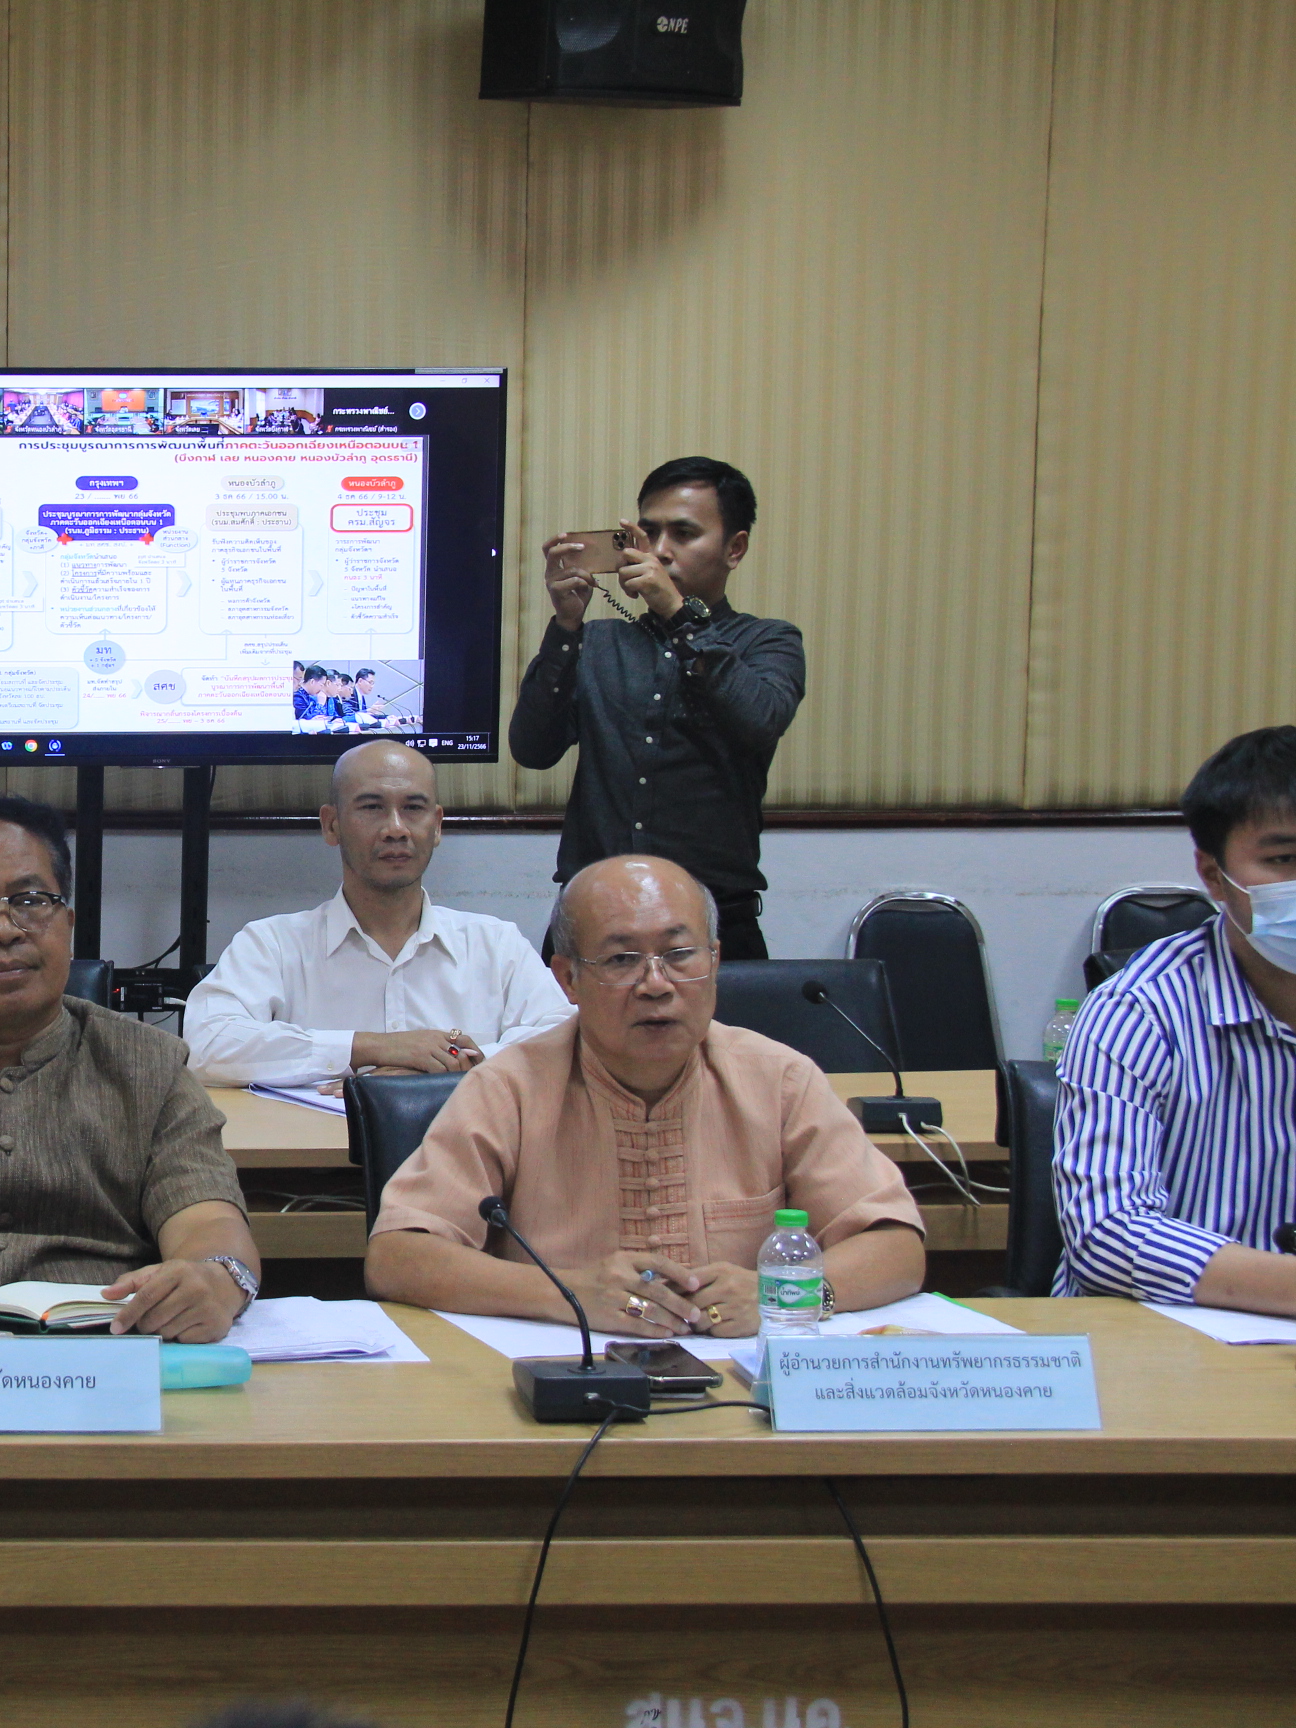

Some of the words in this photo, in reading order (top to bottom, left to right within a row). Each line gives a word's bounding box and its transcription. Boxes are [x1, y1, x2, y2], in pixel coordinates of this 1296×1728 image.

[668, 17, 689, 33] NPE
[413, 441, 418, 449] 1
[174, 453, 216, 465] (บึงกาฬ
[220, 453, 240, 465] เลย
[244, 453, 296, 465] หนองคาย
[301, 453, 367, 465] หนองบัวลำภู
[371, 453, 418, 465] อุดรธานี)
[228, 479, 276, 488] หนองบัวลำภู
[348, 479, 396, 489] หนองบัวลำภู
[357, 509, 387, 519] ประชุม
[348, 518, 396, 528] ครม.สัญจร
[779, 1350, 1081, 1377] ผู้อำนวยการสำนักงานทรัพยากรธรรมชาติ
[815, 1377, 1052, 1400] และสิ่งแวดล้อมจังหวัดหนองคาย
